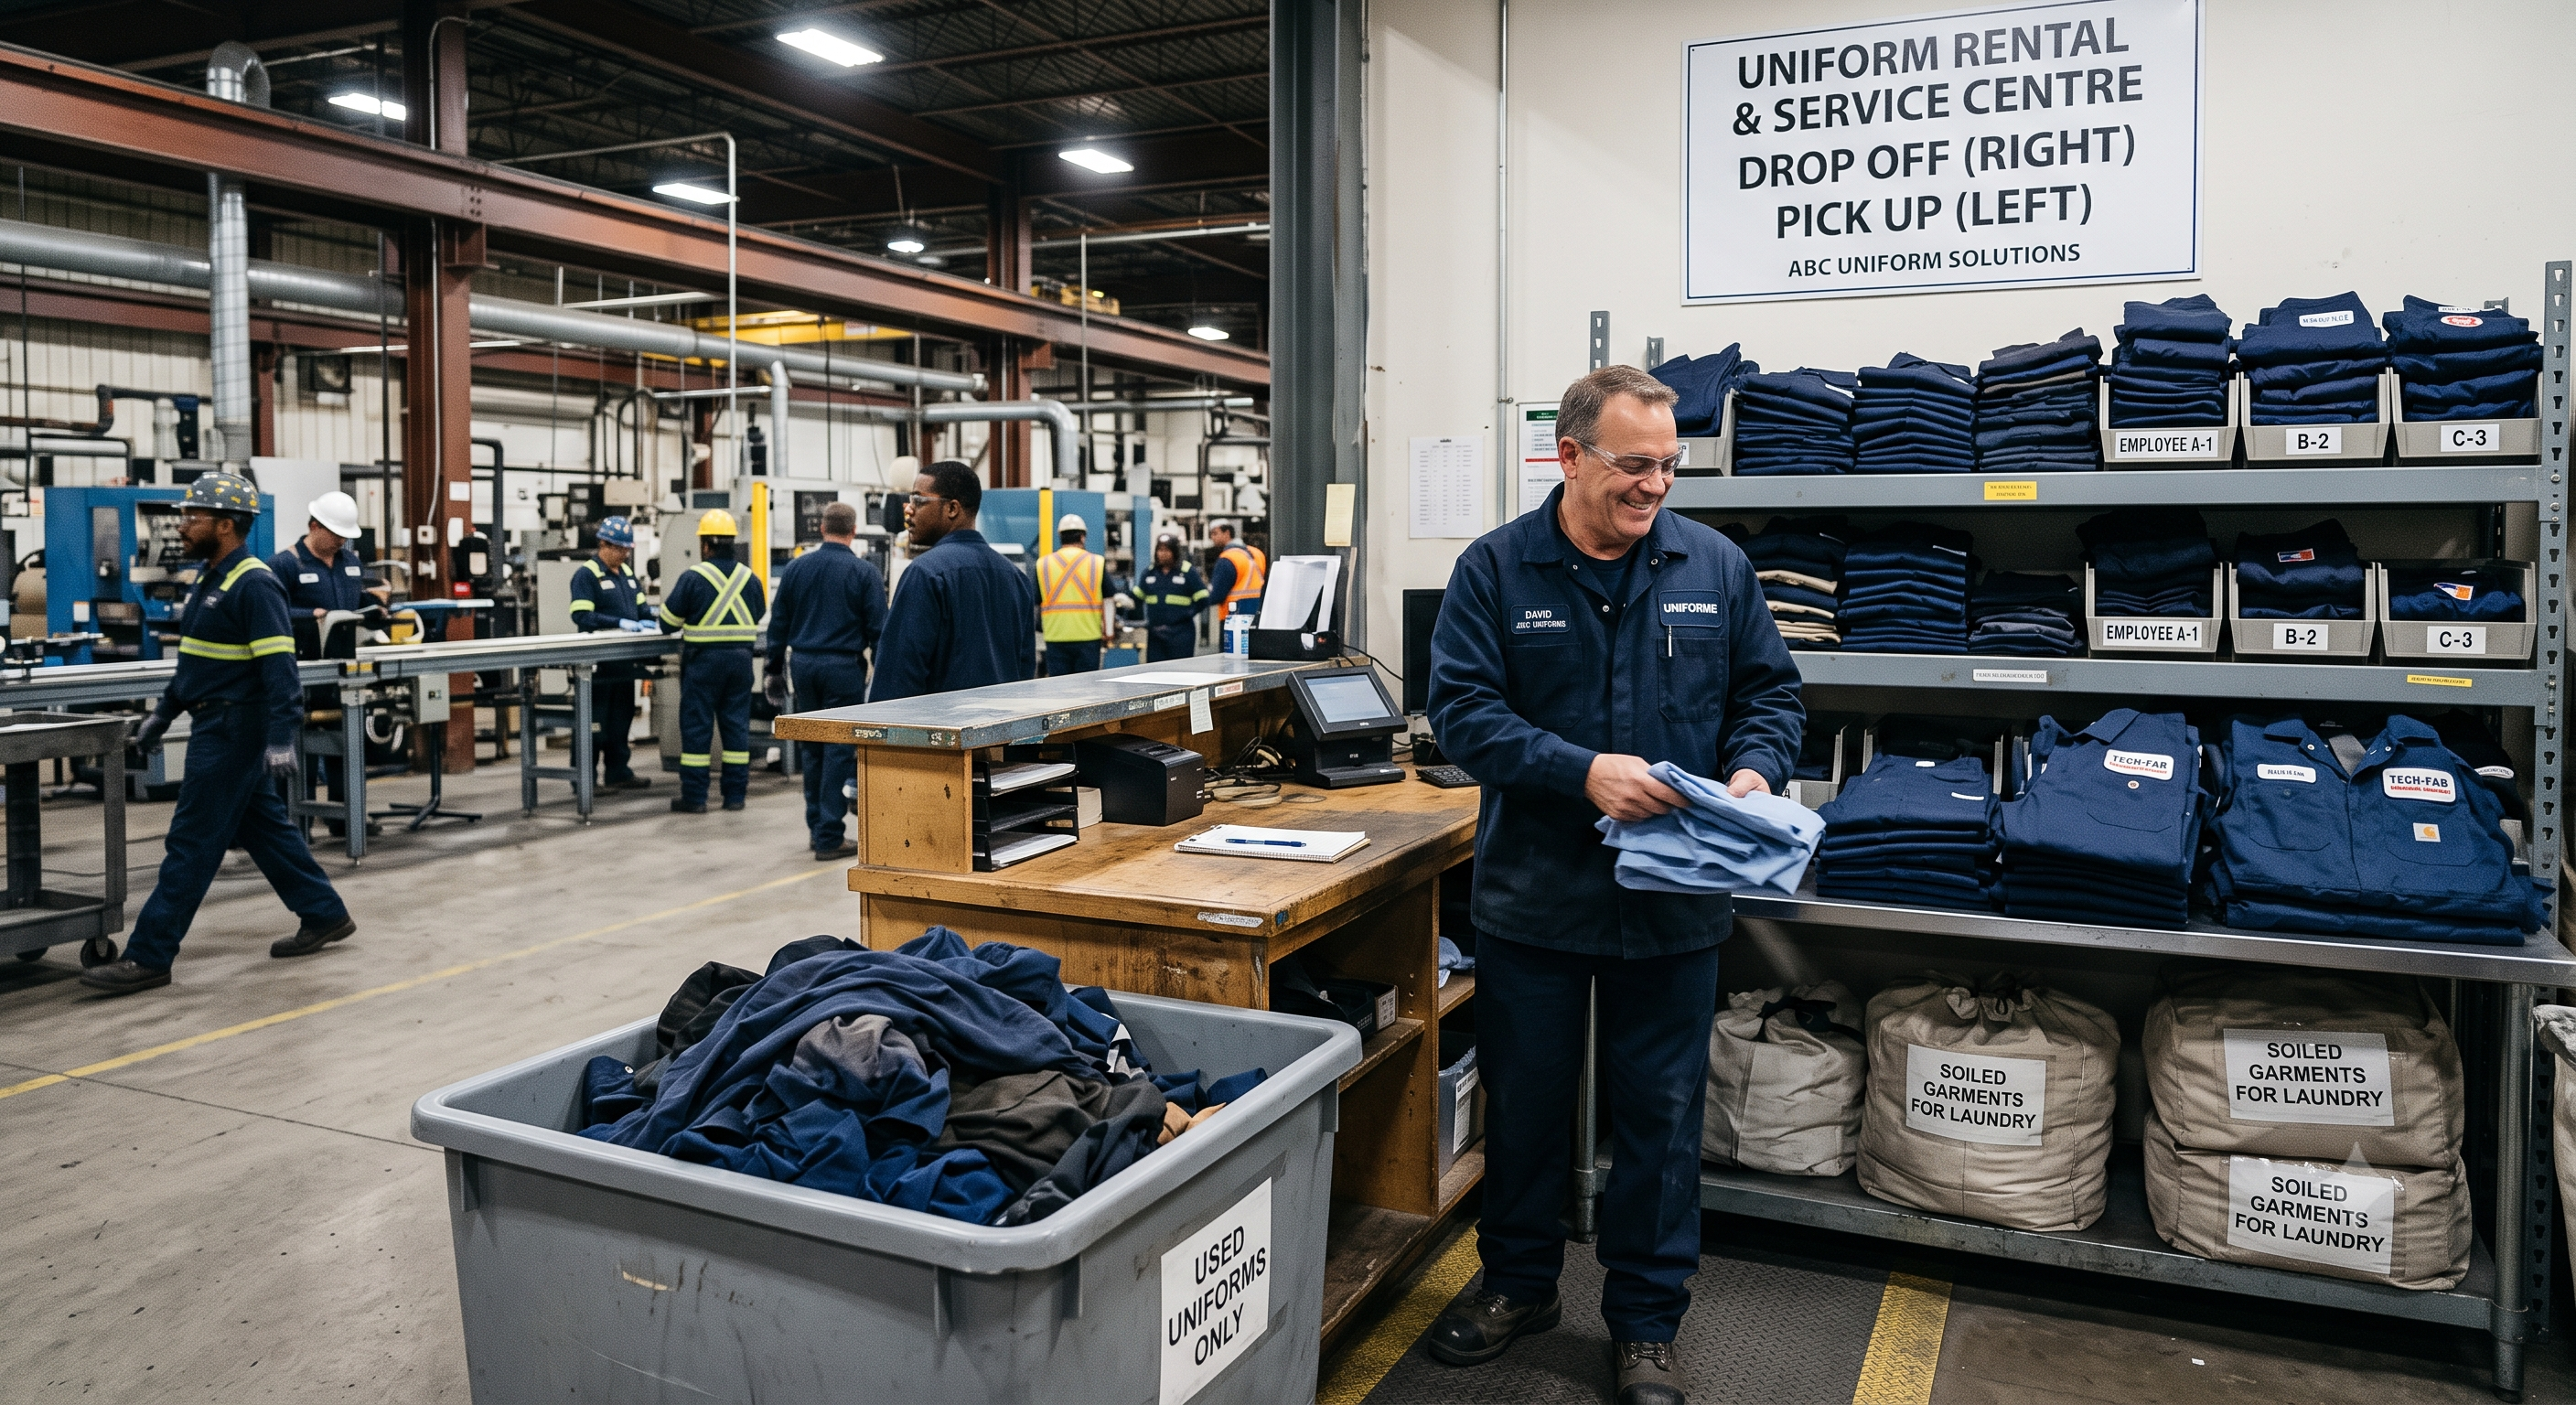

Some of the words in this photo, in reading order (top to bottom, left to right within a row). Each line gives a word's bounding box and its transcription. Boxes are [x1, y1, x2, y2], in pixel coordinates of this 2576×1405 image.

[1738, 37, 1938, 90] UNIFORM
[1954, 16, 2130, 69] RENTAL
[1733, 102, 1762, 136] &
[1774, 83, 1950, 133] SERVICE
[1963, 64, 2143, 115] CENTRE
[1739, 148, 1855, 190] DROP
[1867, 140, 1950, 179] OFF
[1964, 123, 2136, 178] (RIGHT)
[1777, 199, 1873, 239] PICK
[1884, 195, 1942, 232] UP
[1956, 183, 2093, 233] (LEFT)
[1788, 258, 1831, 277] ABC
[1838, 252, 1942, 274] UNIFORM
[1948, 243, 2081, 268] SOLUTIONS
[2120, 437, 2187, 453] EMPLOYEE
[2191, 436, 2213, 452] A-1
[2297, 433, 2329, 450] B-2
[2452, 430, 2487, 447] C-3
[1525, 610, 1552, 619] DAVID
[1663, 603, 1718, 614] UNIFORME
[2106, 625, 2174, 641] EMPLOYEE
[2176, 626, 2198, 642] A-1
[2285, 628, 2317, 646] B-2
[2439, 630, 2474, 649] C-3
[2112, 755, 2168, 769] TECH-FAR
[2388, 775, 2449, 788] TECH-FAB
[2266, 1042, 2343, 1060] SOILED
[1939, 1063, 2007, 1086] SOILED
[2249, 1064, 2367, 1084] GARMENTS
[1923, 1080, 2023, 1108] GARMENTS
[2236, 1085, 2279, 1104] FOR
[2283, 1088, 2384, 1108] LAUNDRY
[1911, 1098, 1946, 1120] FOR
[1950, 1106, 2037, 1130] LAUNDRY
[2270, 1175, 2348, 1203] SOILED
[2250, 1195, 2369, 1228] GARMENTS
[2235, 1212, 2277, 1237] FOR
[2282, 1223, 2386, 1254] LAUNDRY
[1195, 1225, 1245, 1285] USED
[1168, 1247, 1267, 1346] UNIFORMS
[1195, 1302, 1245, 1367] ONLY
